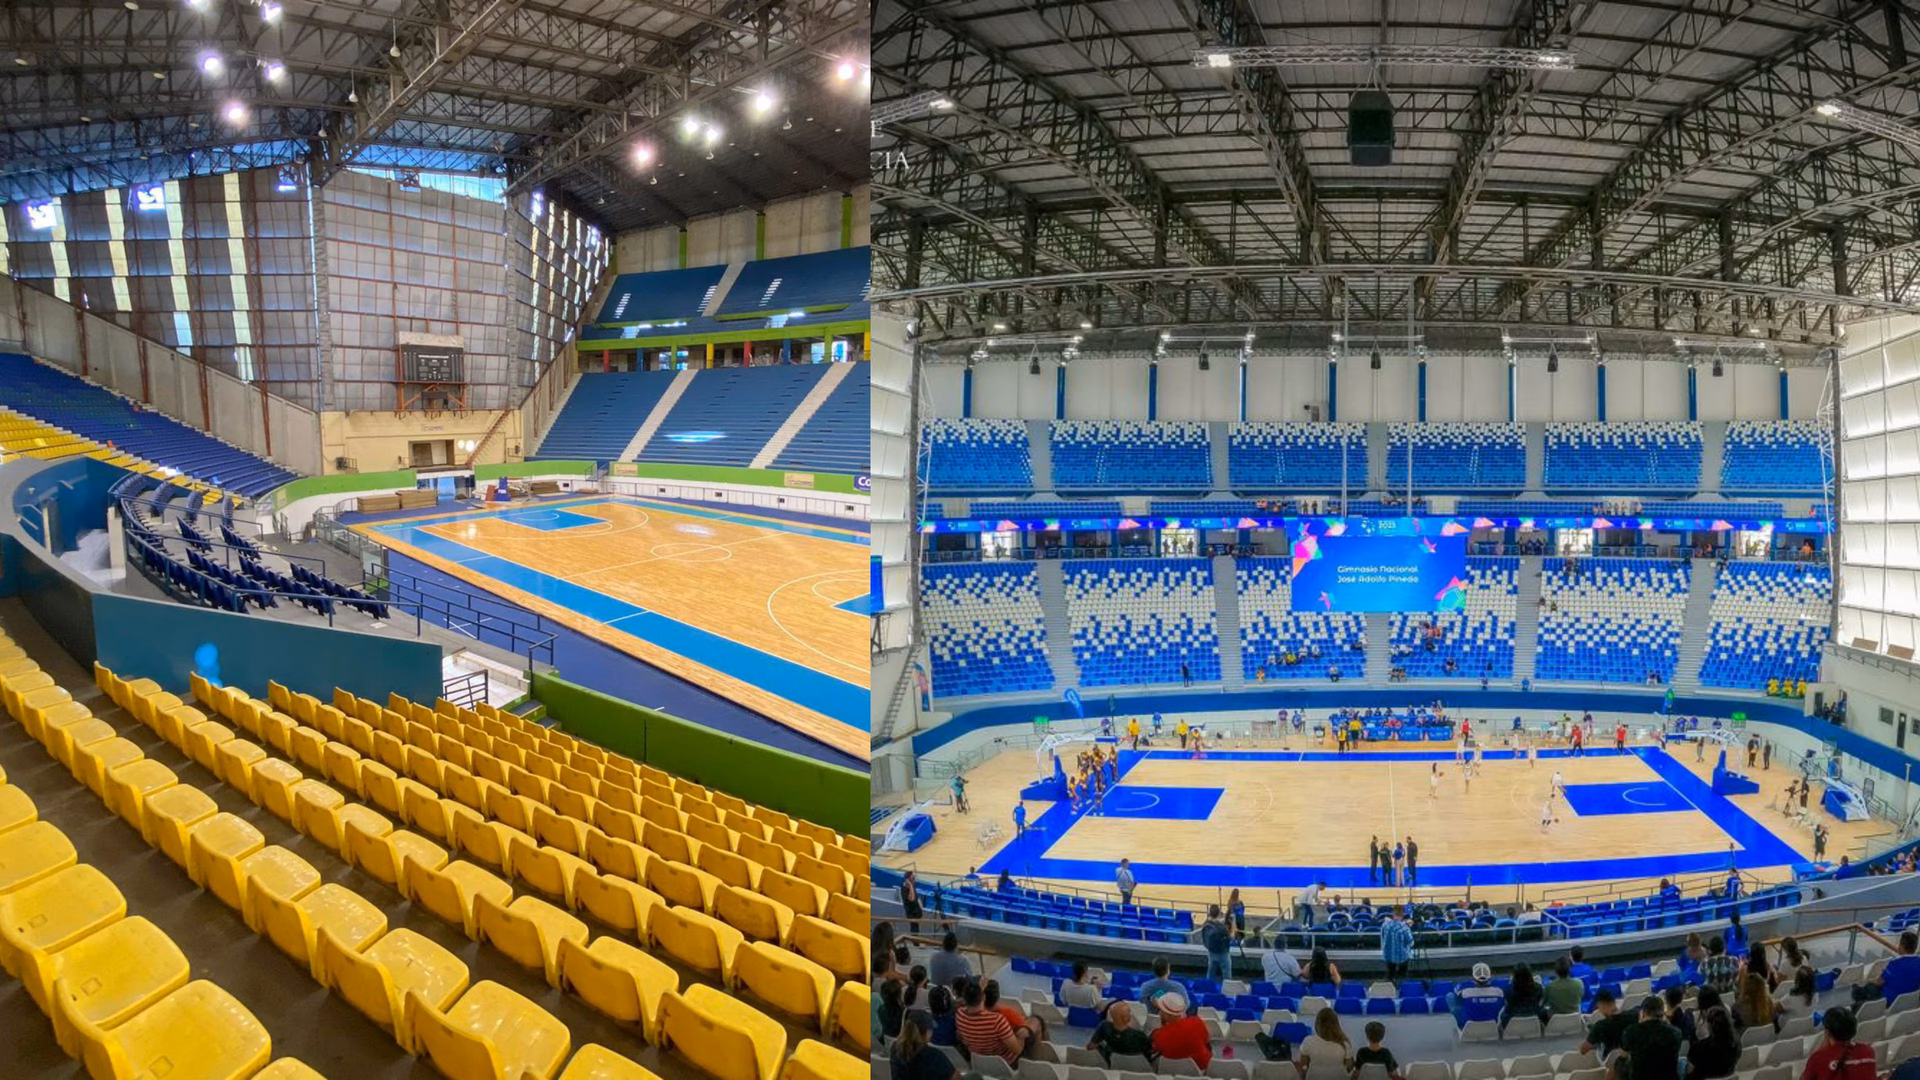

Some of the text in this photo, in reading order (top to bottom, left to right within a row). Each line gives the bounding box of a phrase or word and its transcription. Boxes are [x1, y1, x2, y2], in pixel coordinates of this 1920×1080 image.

[1337, 565, 1418, 573] Gimnasio Nacional
[1337, 574, 1356, 583] José
[1358, 575, 1386, 583] Adolfo
